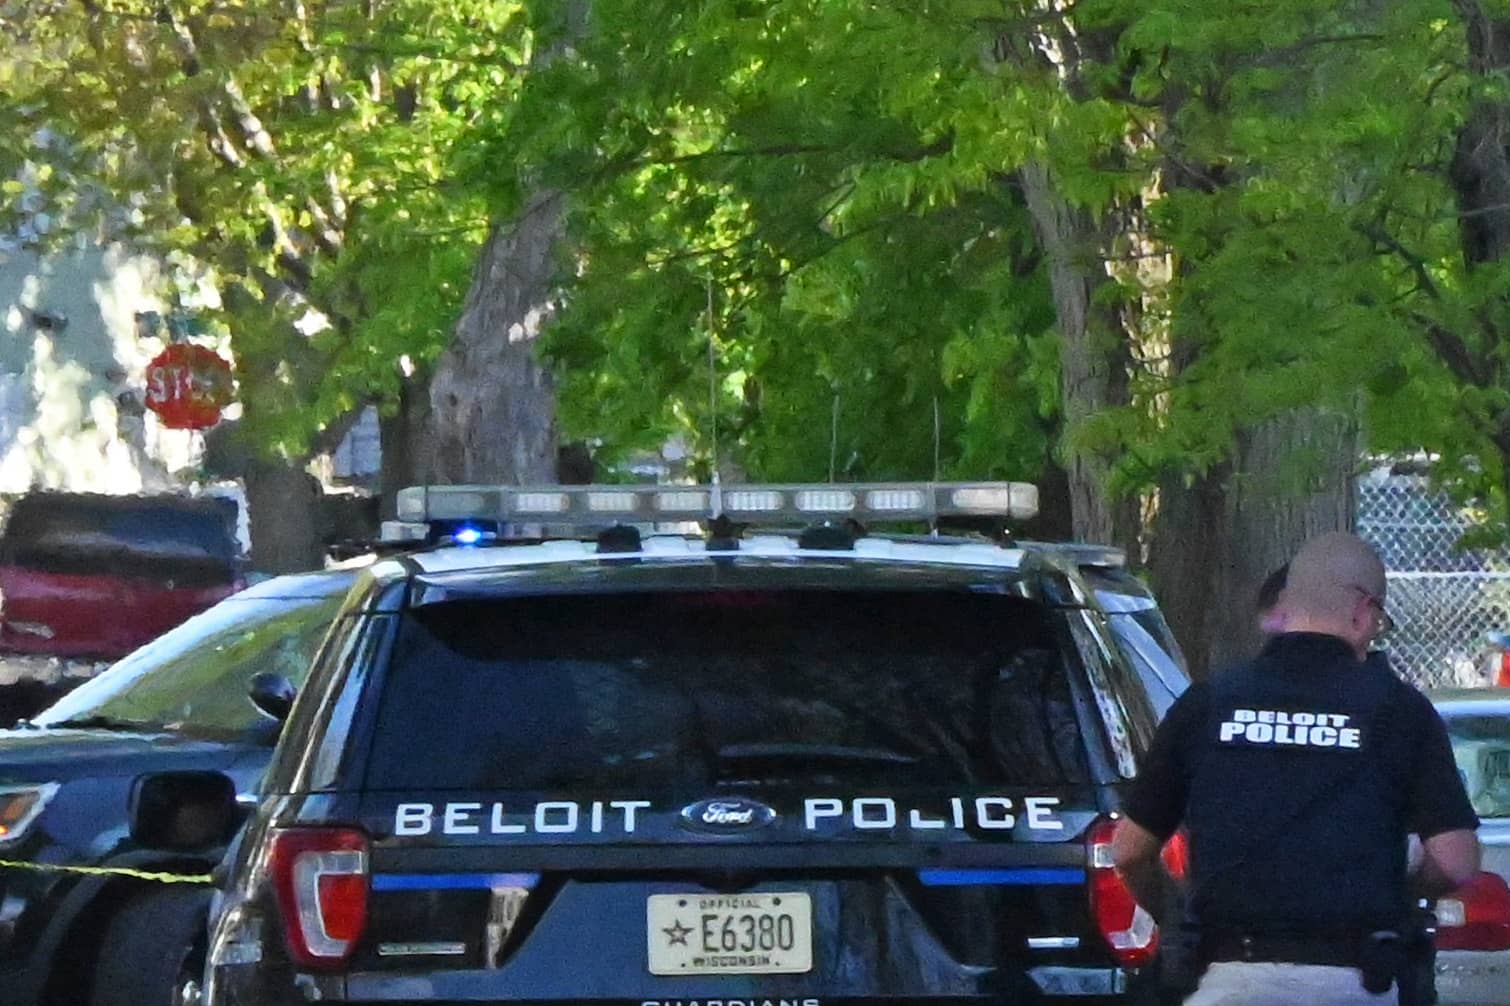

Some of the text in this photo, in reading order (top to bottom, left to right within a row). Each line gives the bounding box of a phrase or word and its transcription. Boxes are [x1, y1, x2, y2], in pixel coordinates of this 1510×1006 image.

[149, 366, 228, 403] ST
[1233, 709, 1350, 728] BELOIT
[1219, 721, 1361, 749] POLICE
[395, 800, 650, 836] BELOIT
[702, 802, 753, 824] Ford
[804, 797, 1064, 830] POLICE
[699, 899, 761, 910] OFFICIAL
[701, 913, 795, 953] E6380
[692, 955, 771, 968] WISCONSIN
